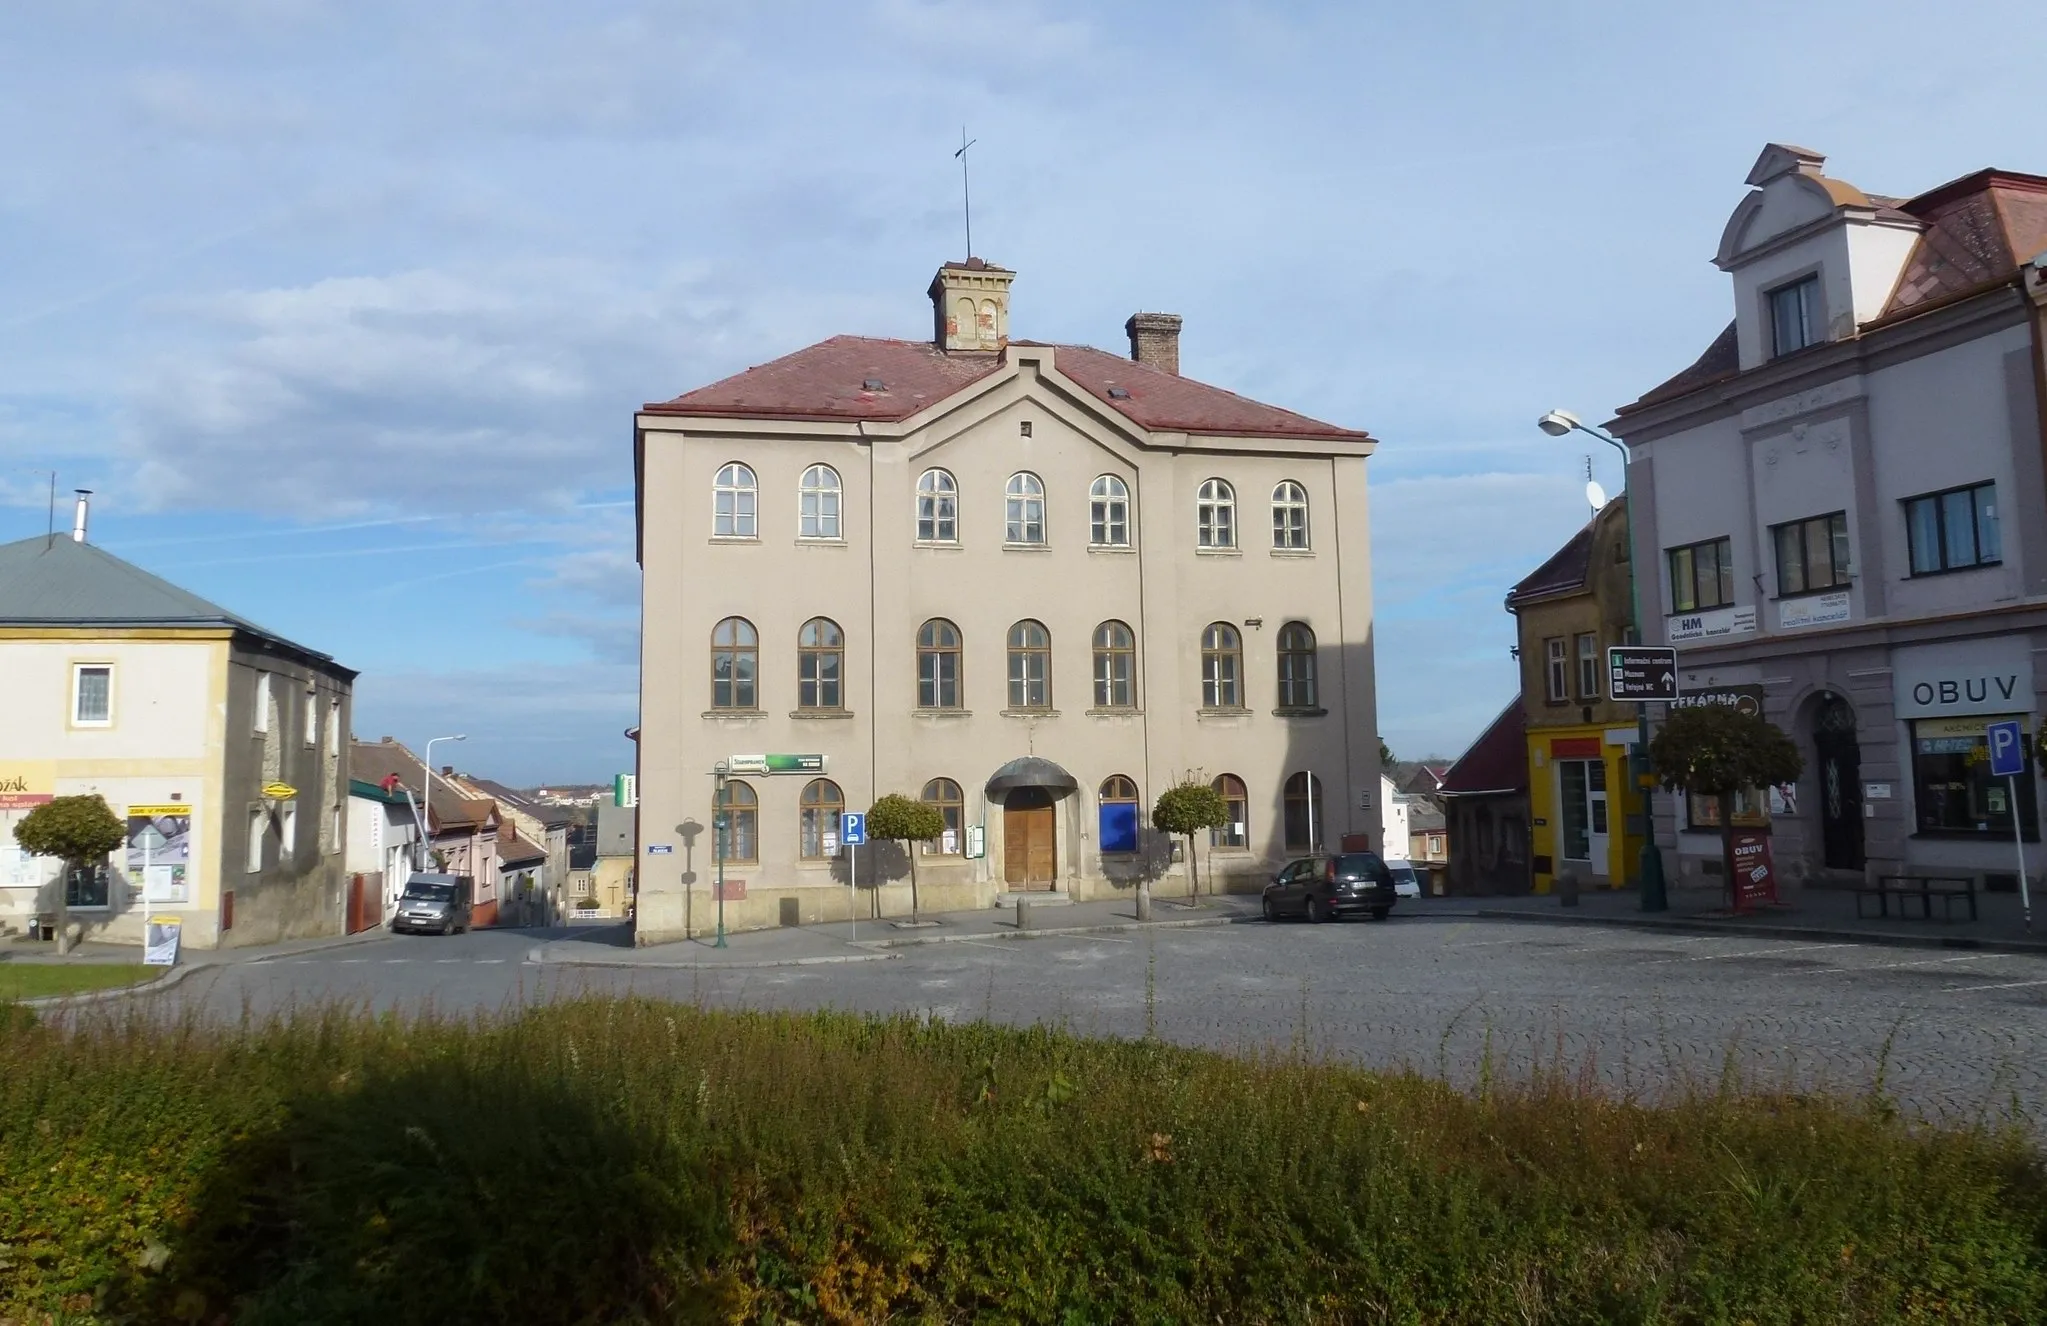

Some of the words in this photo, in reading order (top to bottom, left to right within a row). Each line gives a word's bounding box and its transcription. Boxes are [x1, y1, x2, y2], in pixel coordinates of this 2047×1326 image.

[1682, 618, 1702, 630] HM
[1624, 657, 1651, 665] Informační
[1913, 675, 2017, 705] OBUV
[1994, 729, 2013, 759] P
[848, 815, 858, 833] P
[1735, 845, 1763, 855] OBUV
